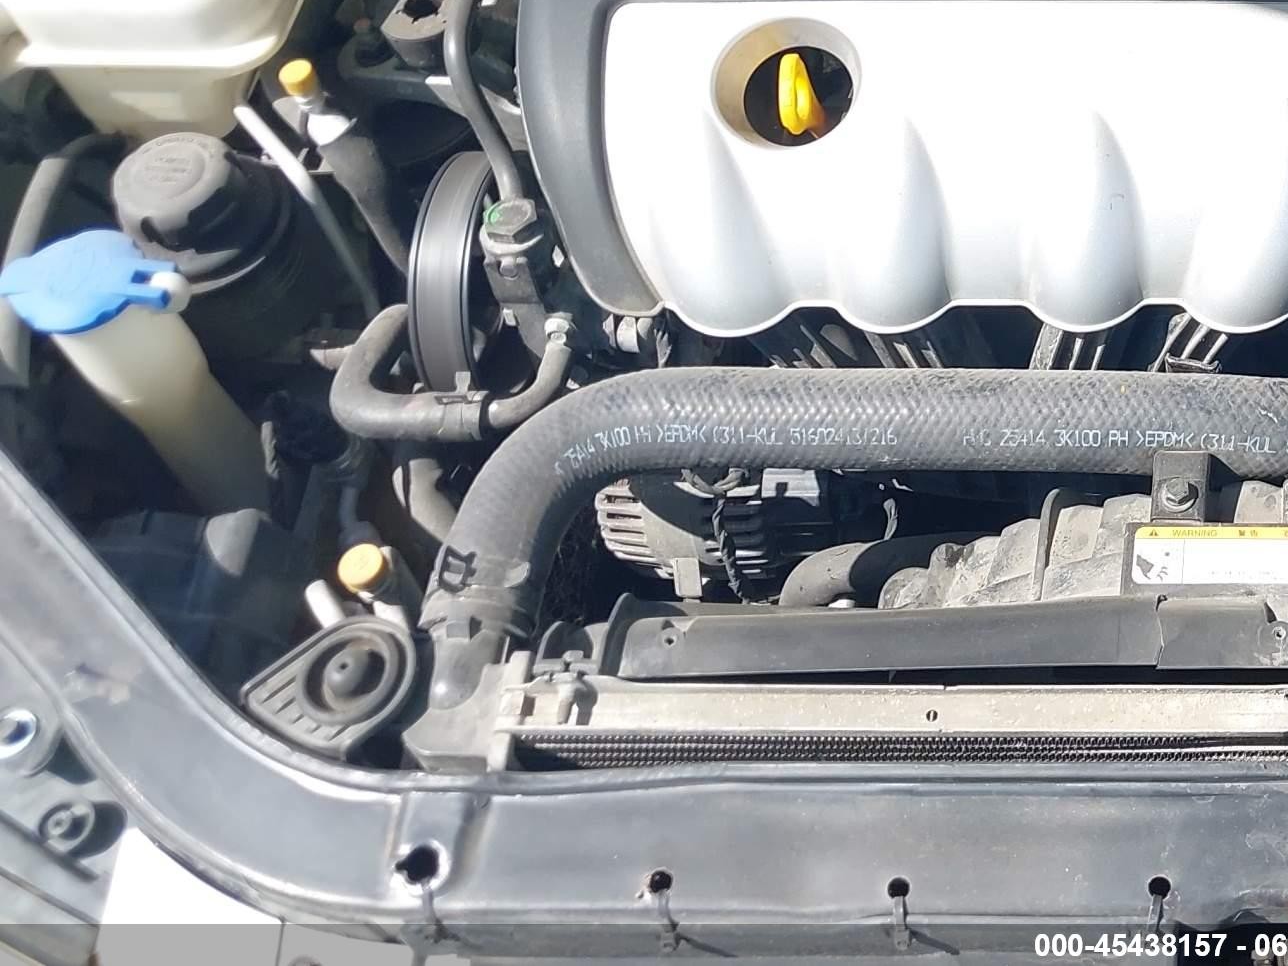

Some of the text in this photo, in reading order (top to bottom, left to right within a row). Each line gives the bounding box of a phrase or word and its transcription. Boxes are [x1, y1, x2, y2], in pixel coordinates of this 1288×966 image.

[1055, 430, 1100, 446] 3K100
[1108, 432, 1129, 447] PH
[1136, 430, 1195, 448] >EPDM<
[1172, 529, 1218, 537] WARNING
